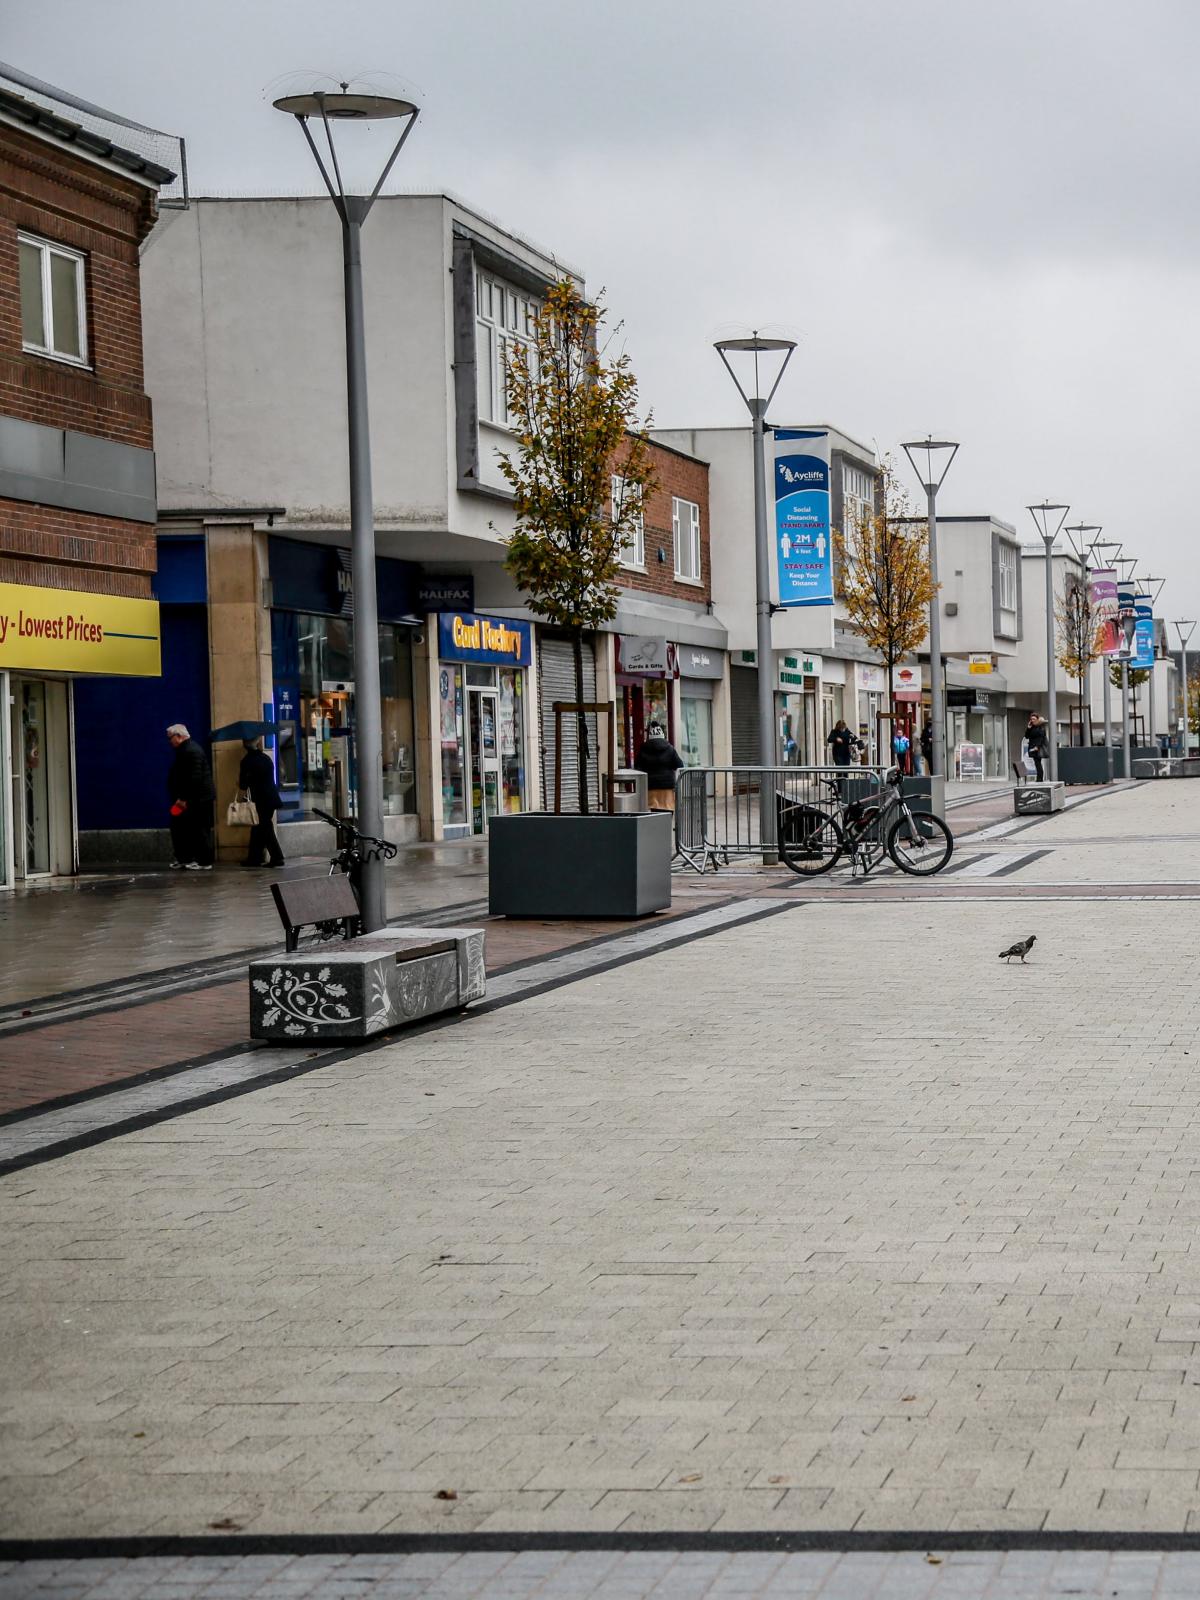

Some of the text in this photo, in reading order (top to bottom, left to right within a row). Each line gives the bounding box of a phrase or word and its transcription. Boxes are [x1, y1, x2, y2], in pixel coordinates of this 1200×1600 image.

[793, 471, 824, 481] Aycliffe
[787, 514, 818, 522] Distancing
[795, 534, 811, 543] 2M
[789, 572, 805, 580] Keep
[419, 590, 470, 599] HALIFAX
[18, 610, 63, 639] Lowest
[66, 615, 102, 642] Prices
[453, 616, 521, 660] Card Factory
